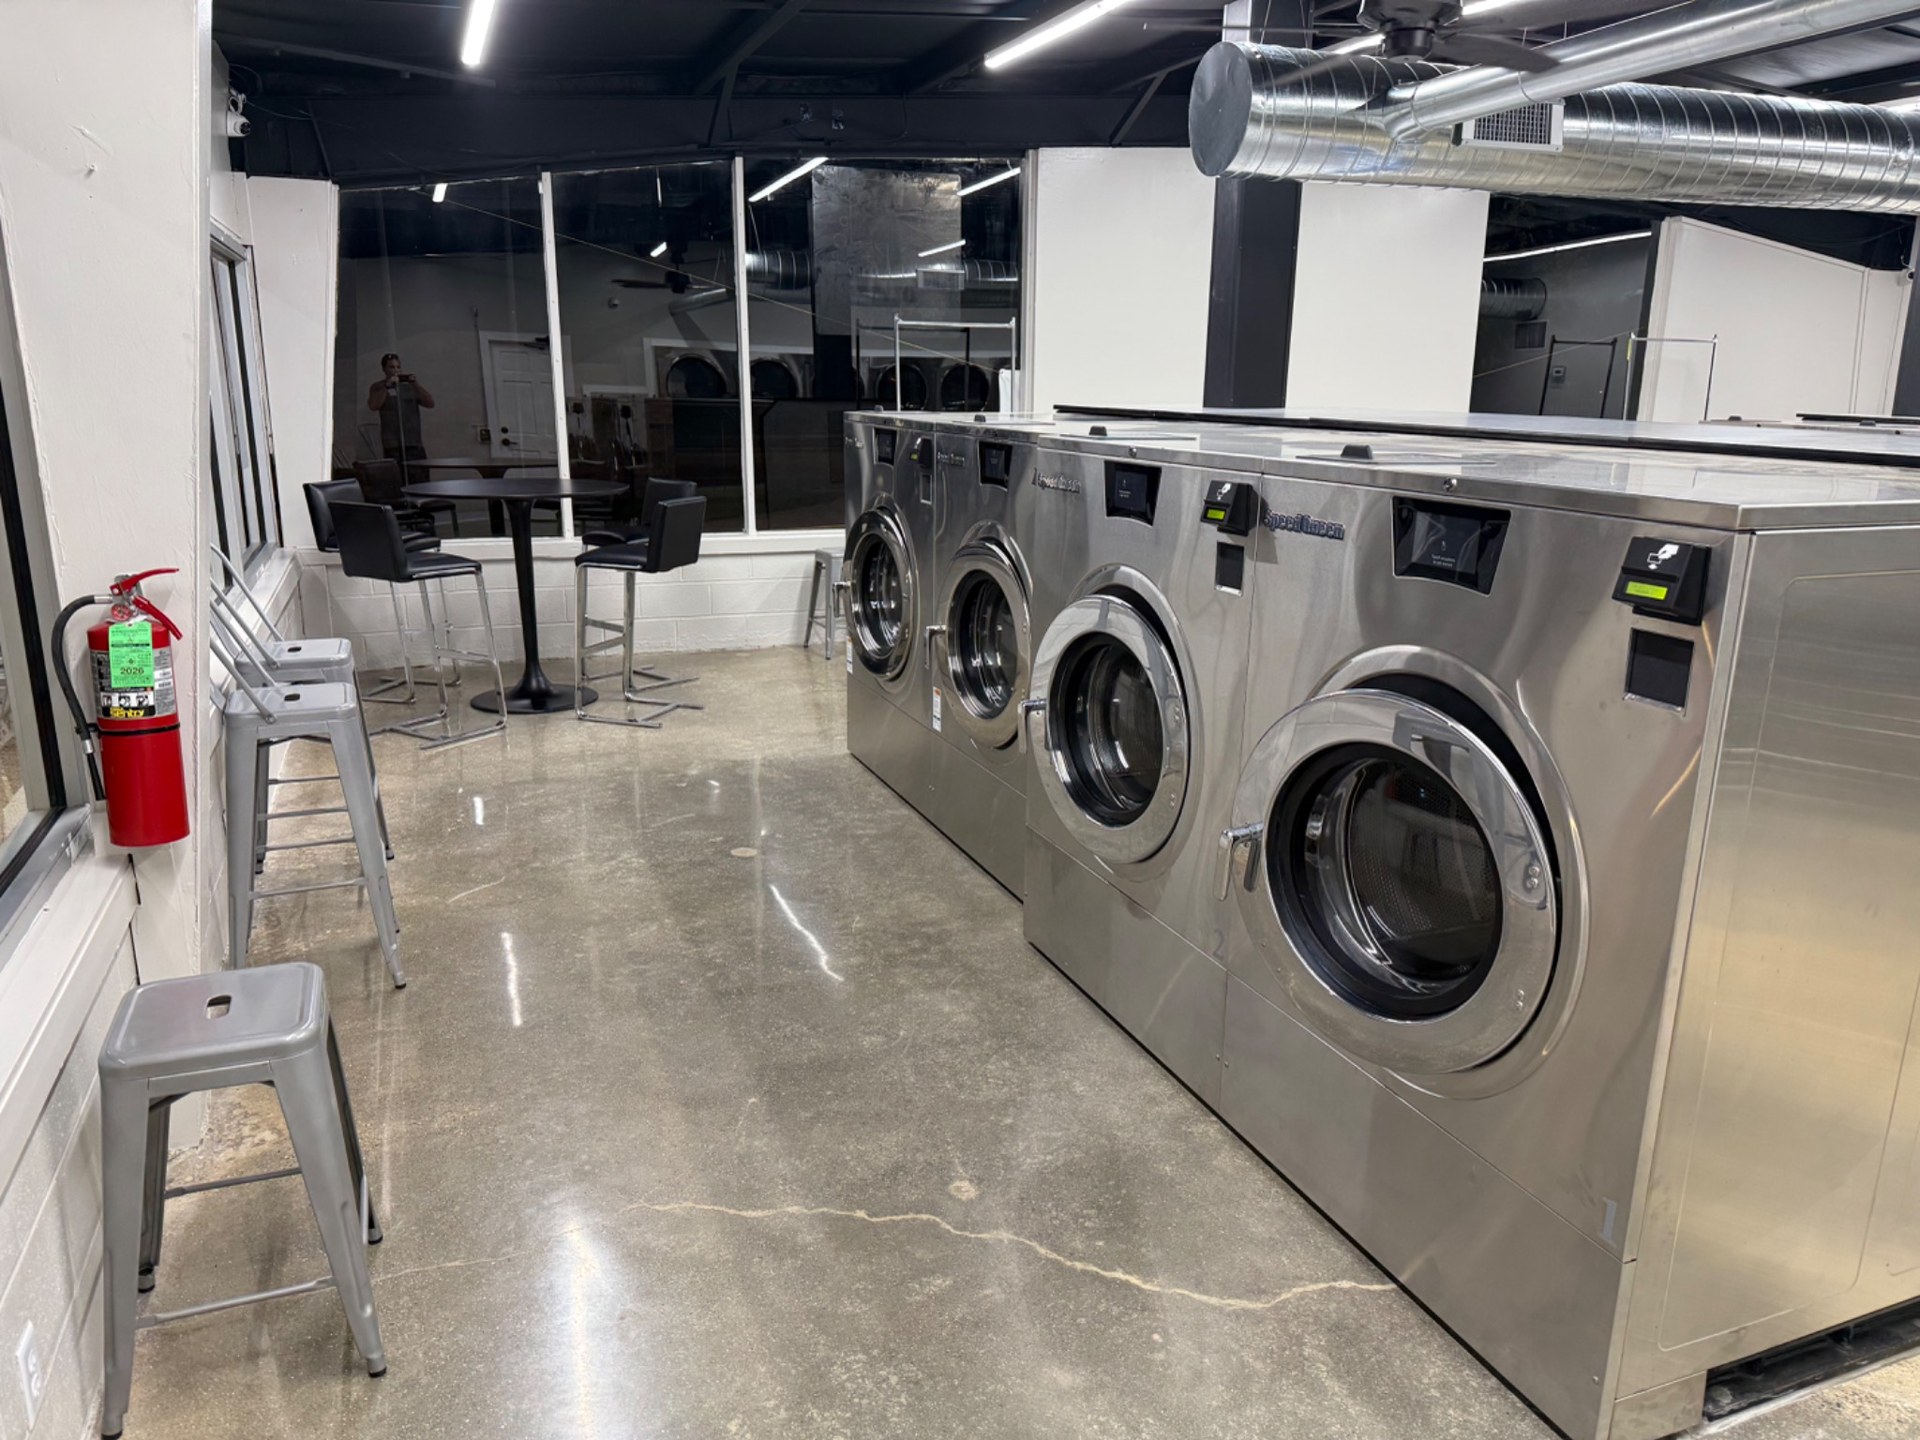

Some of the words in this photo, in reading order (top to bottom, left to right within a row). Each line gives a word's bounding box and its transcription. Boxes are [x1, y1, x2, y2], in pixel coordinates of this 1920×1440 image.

[120, 667, 145, 675] 2026
[1212, 927, 1225, 962] 2
[1599, 1197, 1617, 1248] 1
